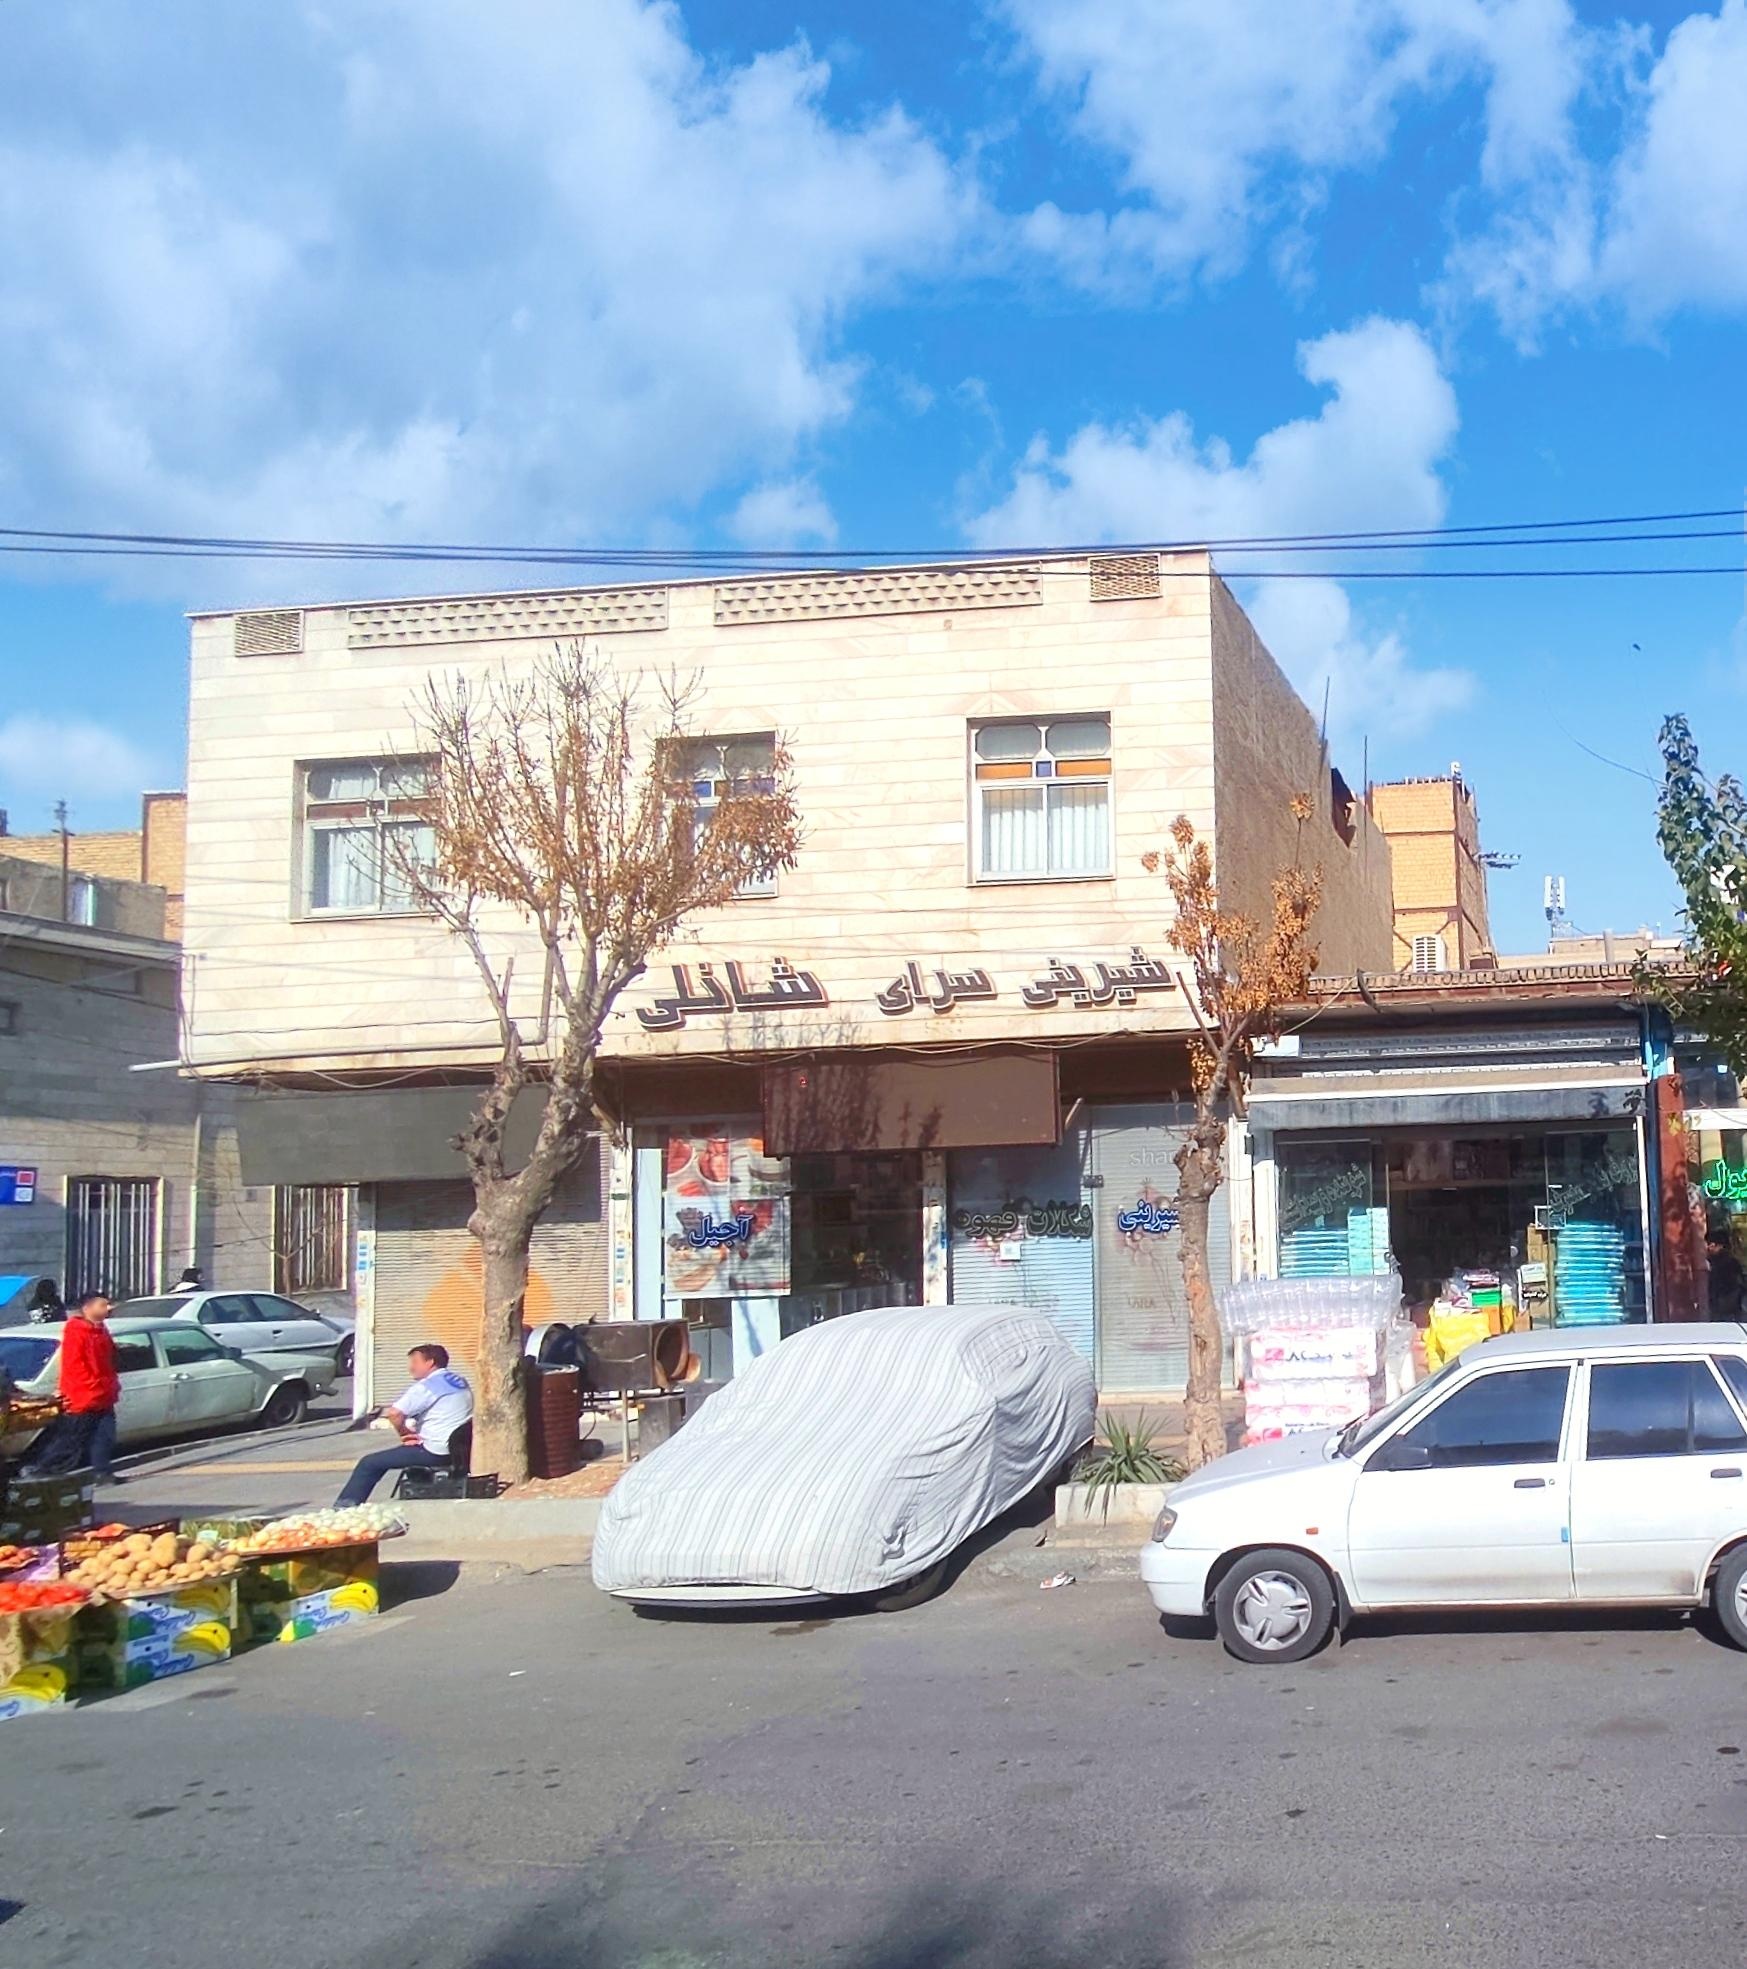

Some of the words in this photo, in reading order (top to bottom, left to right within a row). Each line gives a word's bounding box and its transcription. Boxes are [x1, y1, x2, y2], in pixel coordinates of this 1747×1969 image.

[635, 956, 830, 1033] شانلی
[875, 959, 998, 1016] سرای
[1020, 947, 1178, 1010] شیرینی
[688, 1212, 756, 1248] آجیل
[1025, 1201, 1093, 1239] شکلات
